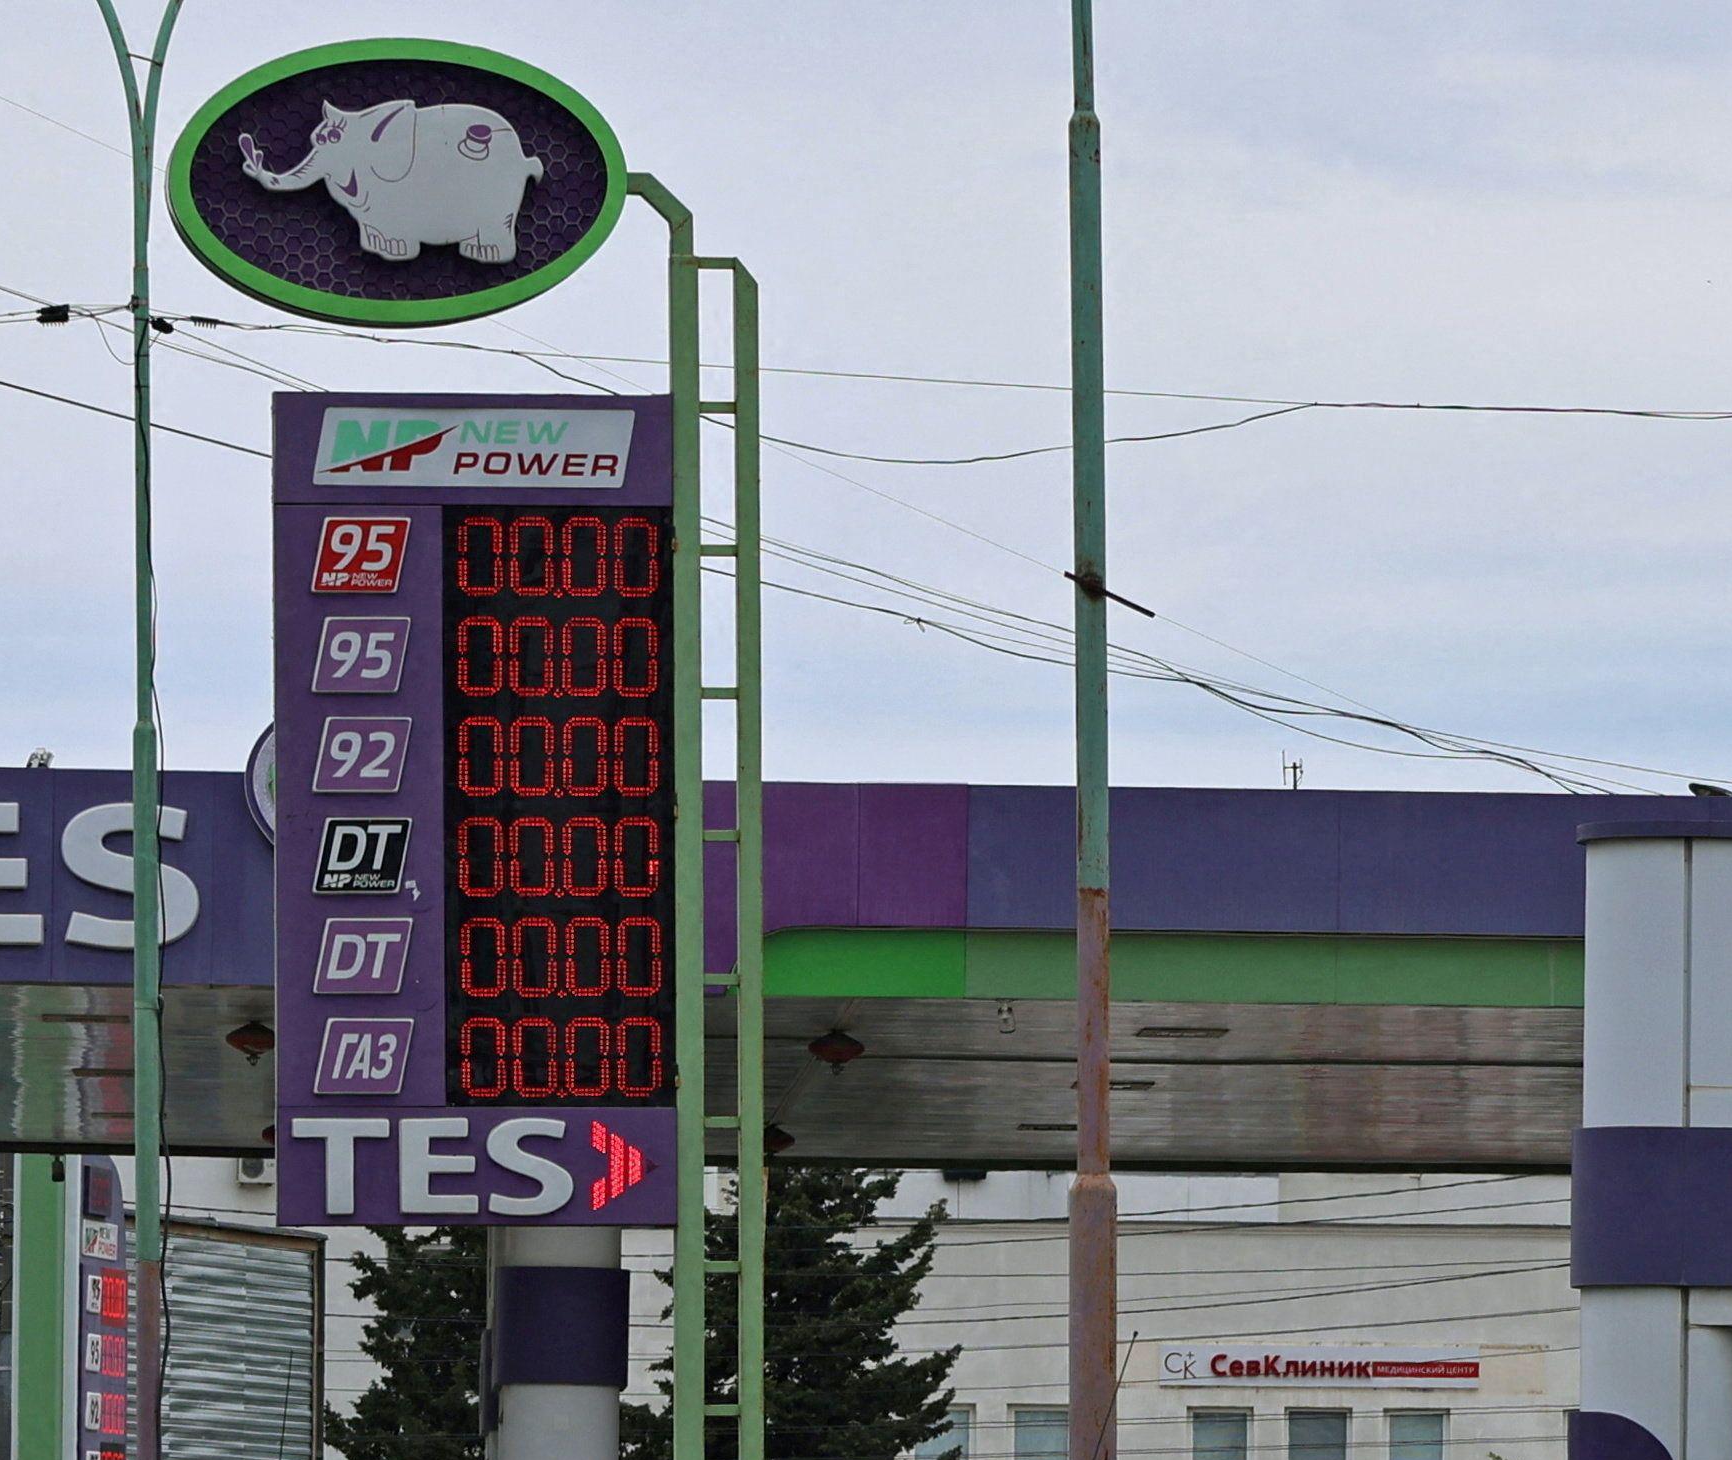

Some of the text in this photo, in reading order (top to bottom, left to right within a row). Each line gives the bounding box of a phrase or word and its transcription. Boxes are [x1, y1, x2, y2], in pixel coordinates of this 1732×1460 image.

[321, 419, 449, 473] NP
[460, 420, 569, 444] NEW
[453, 452, 619, 477] POWER
[330, 524, 393, 571] 95
[457, 516, 659, 598] 00.00
[350, 579, 393, 587] POWER
[329, 631, 392, 679] 95
[457, 616, 659, 698] 00.00
[329, 731, 395, 779] 92
[457, 716, 659, 798] 00.00
[327, 825, 402, 871] DT
[457, 816, 660, 898] 00.00
[352, 880, 395, 888] POWER
[326, 933, 401, 980] DT
[460, 917, 662, 998] 00.00
[331, 1034, 397, 1080] ГАЗ
[460, 1017, 662, 1098] 00.00
[291, 1117, 573, 1216] TES
[90, 1340, 100, 1365] 95
[1210, 1354, 1371, 1379] СевКлиник
[1376, 1364, 1476, 1376] МЕДИЦИНСКИЙ ЦЕНТР
